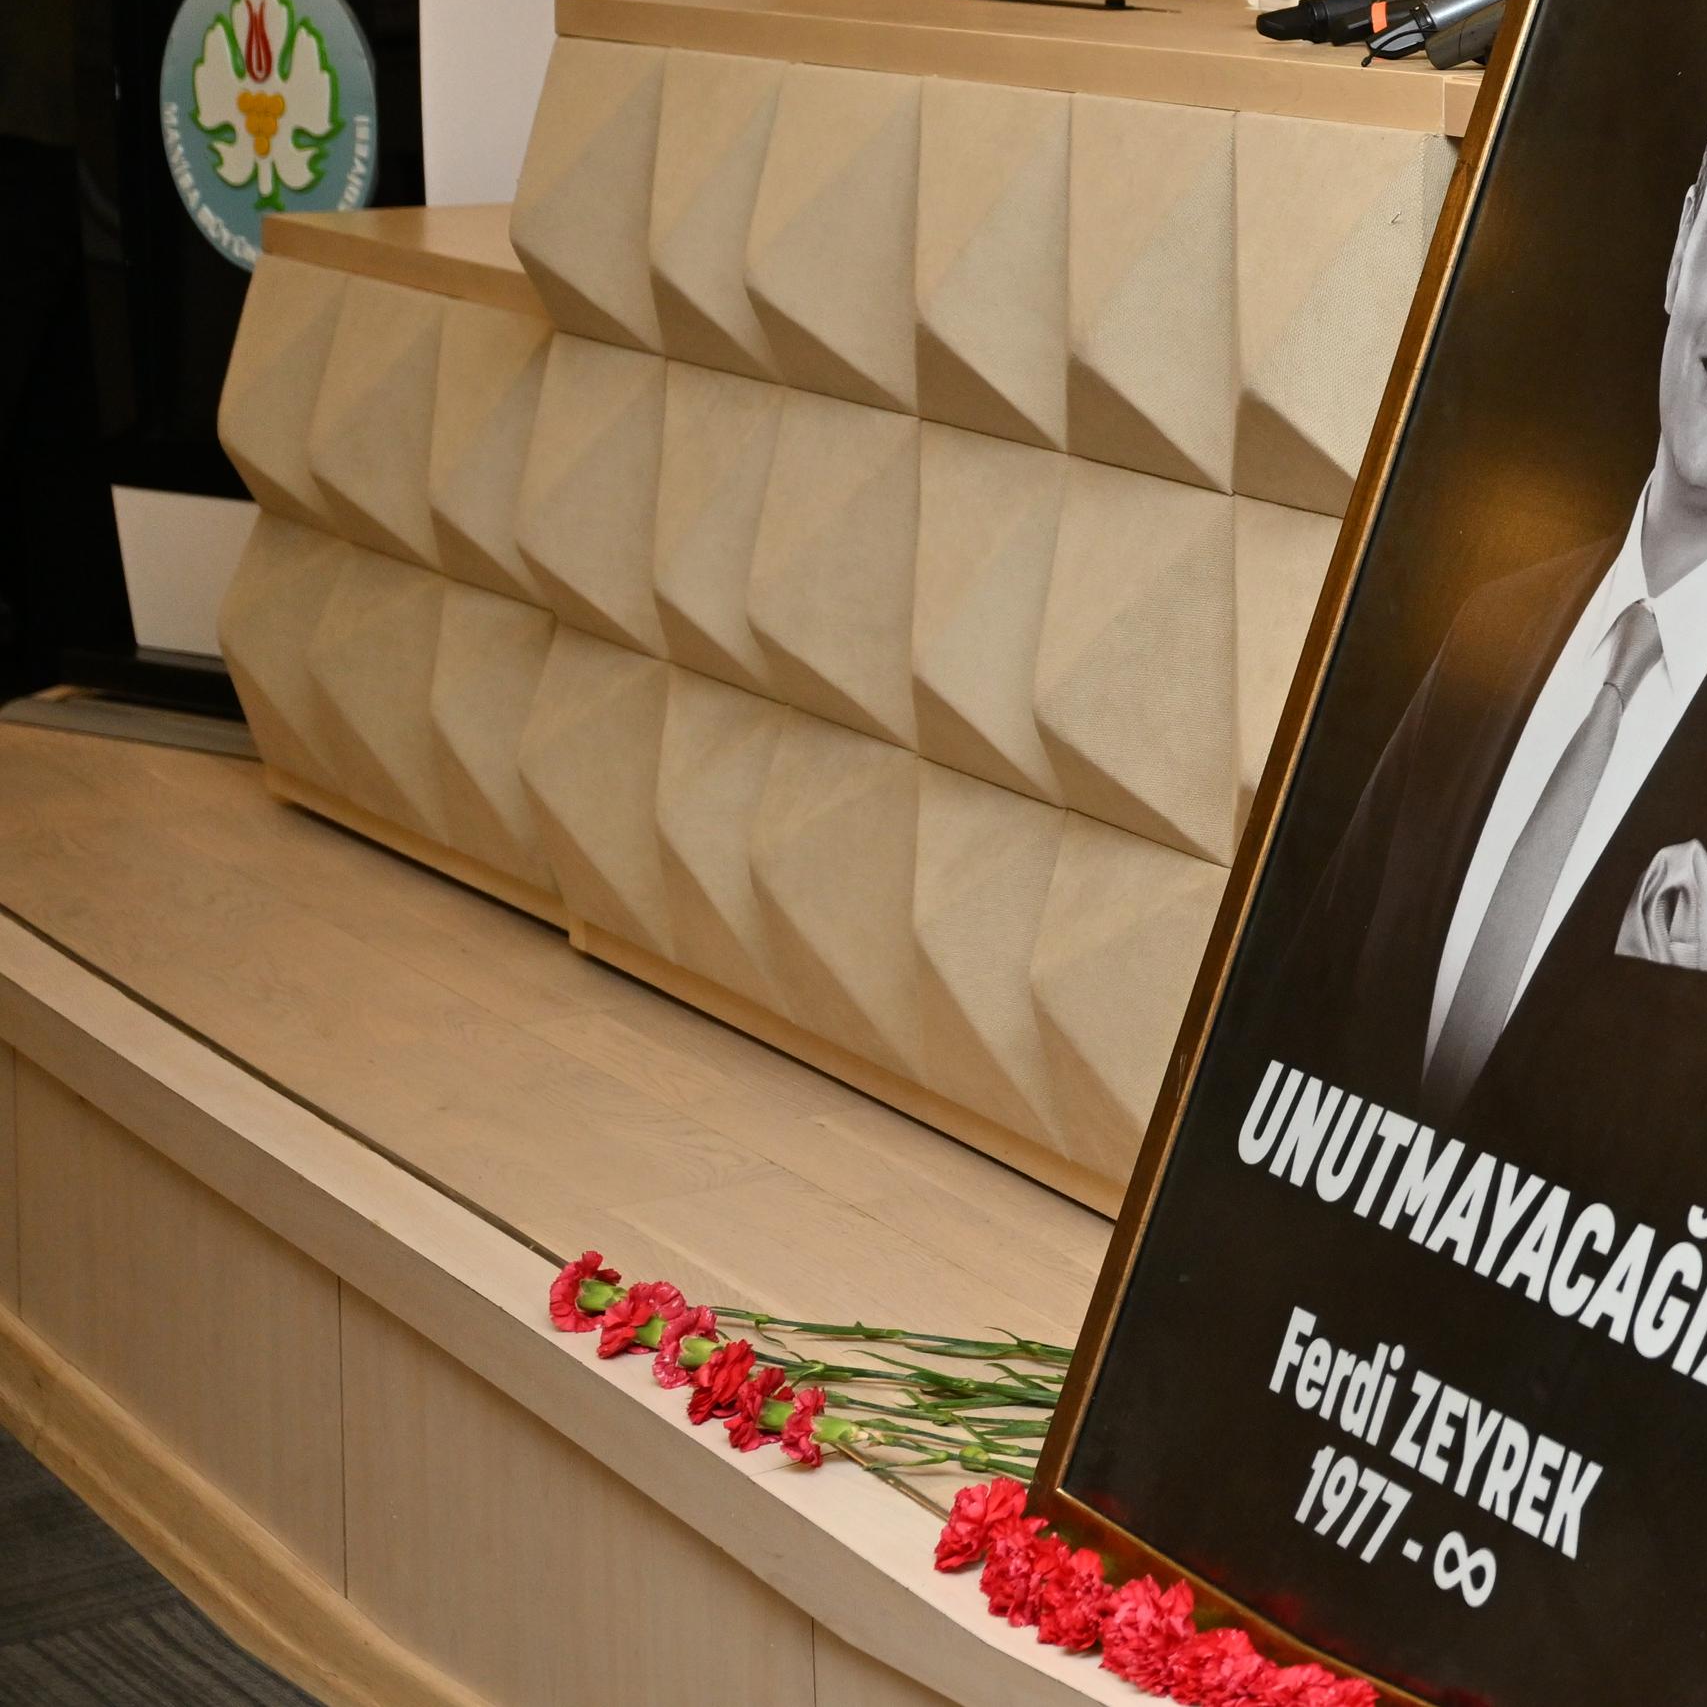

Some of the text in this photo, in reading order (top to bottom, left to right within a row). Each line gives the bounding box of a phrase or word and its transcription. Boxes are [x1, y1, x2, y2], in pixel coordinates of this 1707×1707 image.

[1267, 1305, 1604, 1561] Ferdi ZEYREK
[1293, 1444, 1413, 1564] 1977
